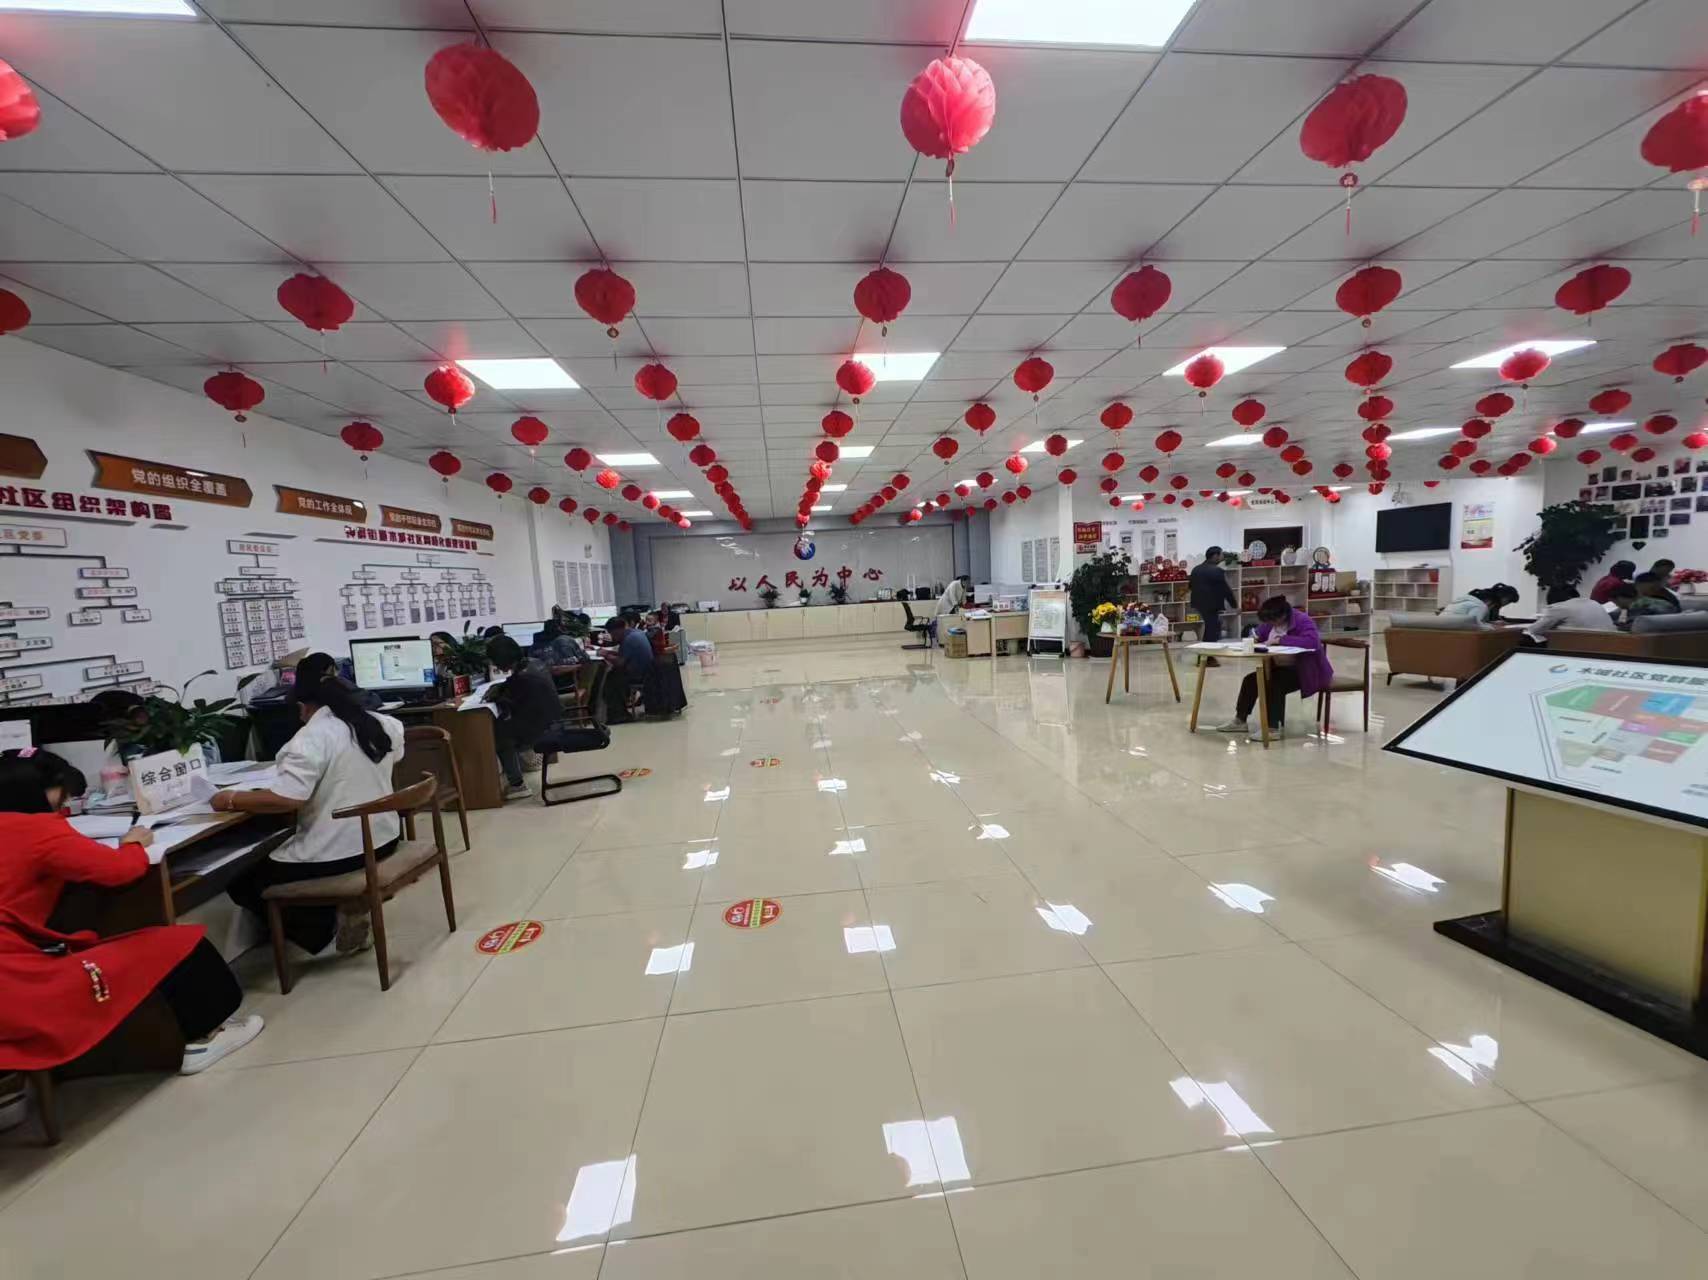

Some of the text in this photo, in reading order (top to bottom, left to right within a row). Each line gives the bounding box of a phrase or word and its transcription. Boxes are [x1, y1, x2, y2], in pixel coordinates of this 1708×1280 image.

[131, 467, 228, 498] 党的组织全覆盖
[728, 565, 884, 593] 以人民为中心
[141, 758, 202, 786] 综合窗口
